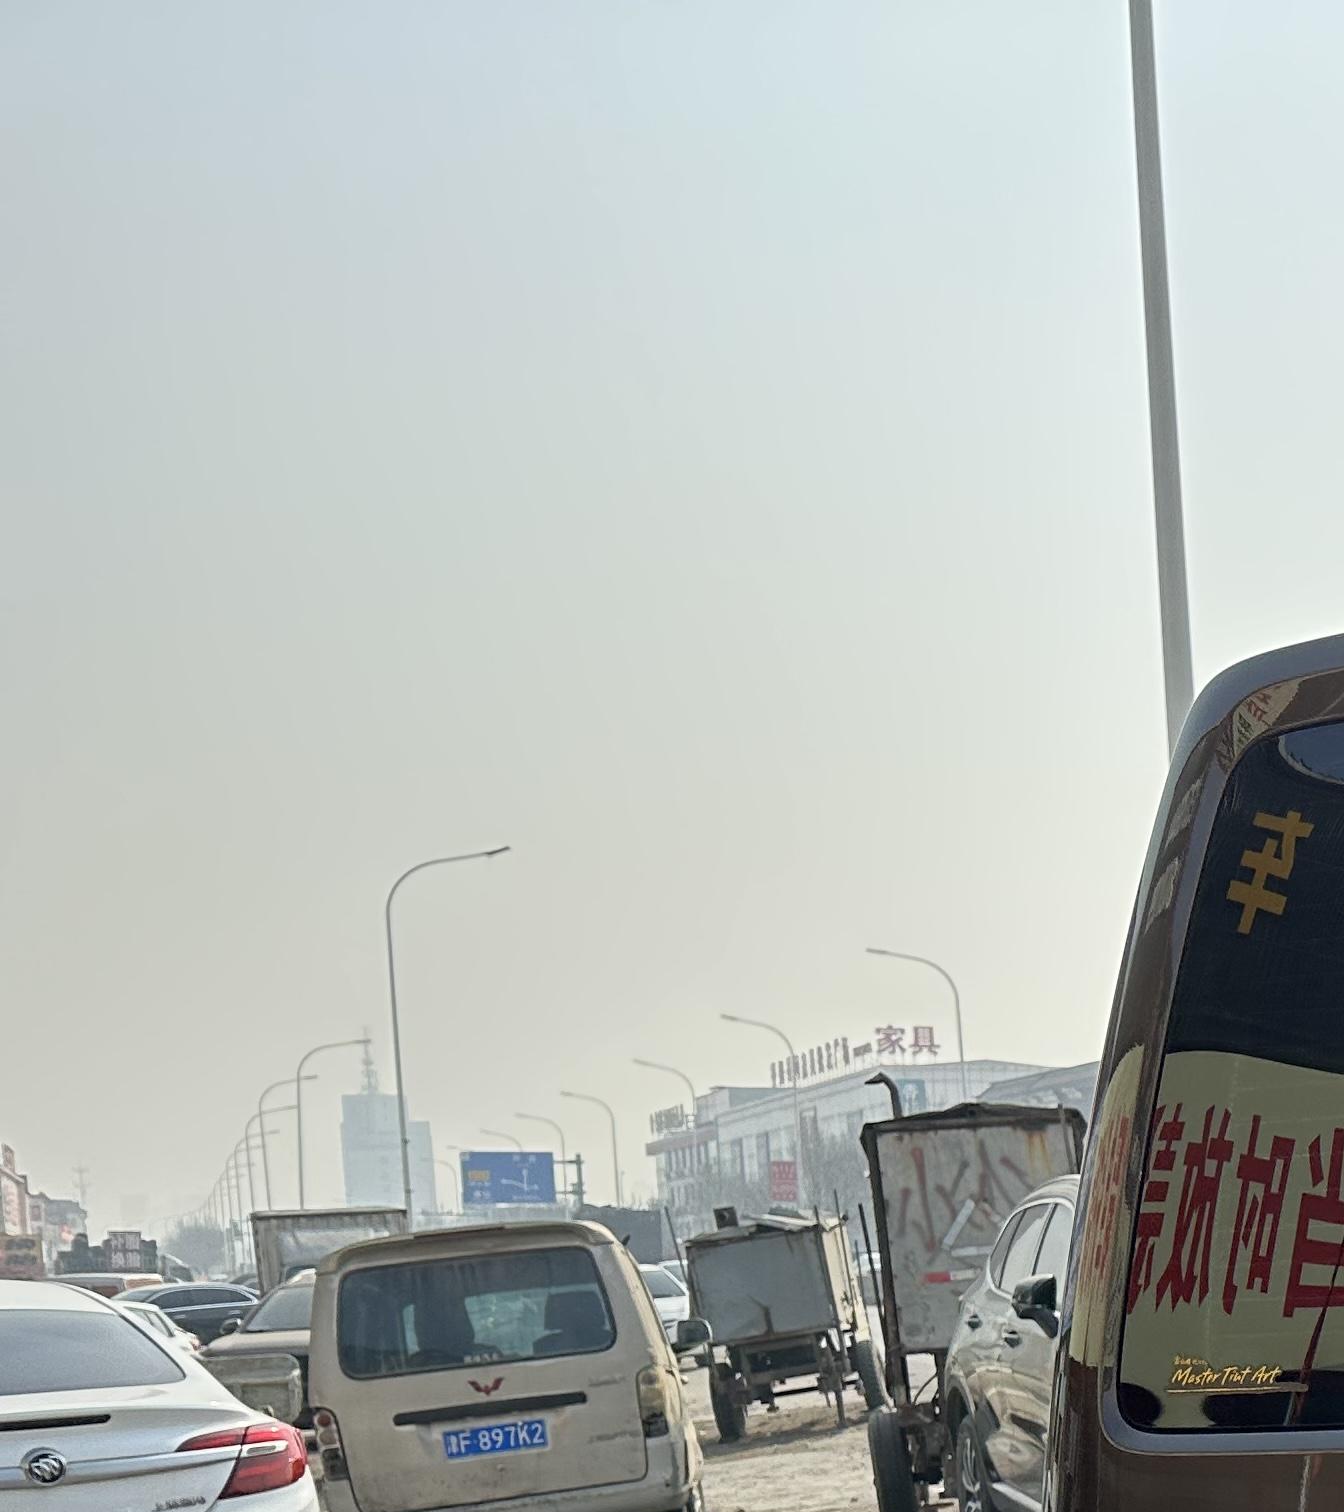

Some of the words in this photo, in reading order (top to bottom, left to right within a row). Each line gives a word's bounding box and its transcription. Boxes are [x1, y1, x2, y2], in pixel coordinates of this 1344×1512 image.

[874, 1025, 941, 1057] 家具
[1171, 1366, 1221, 1386] Master
[1250, 1365, 1283, 1385] Art
